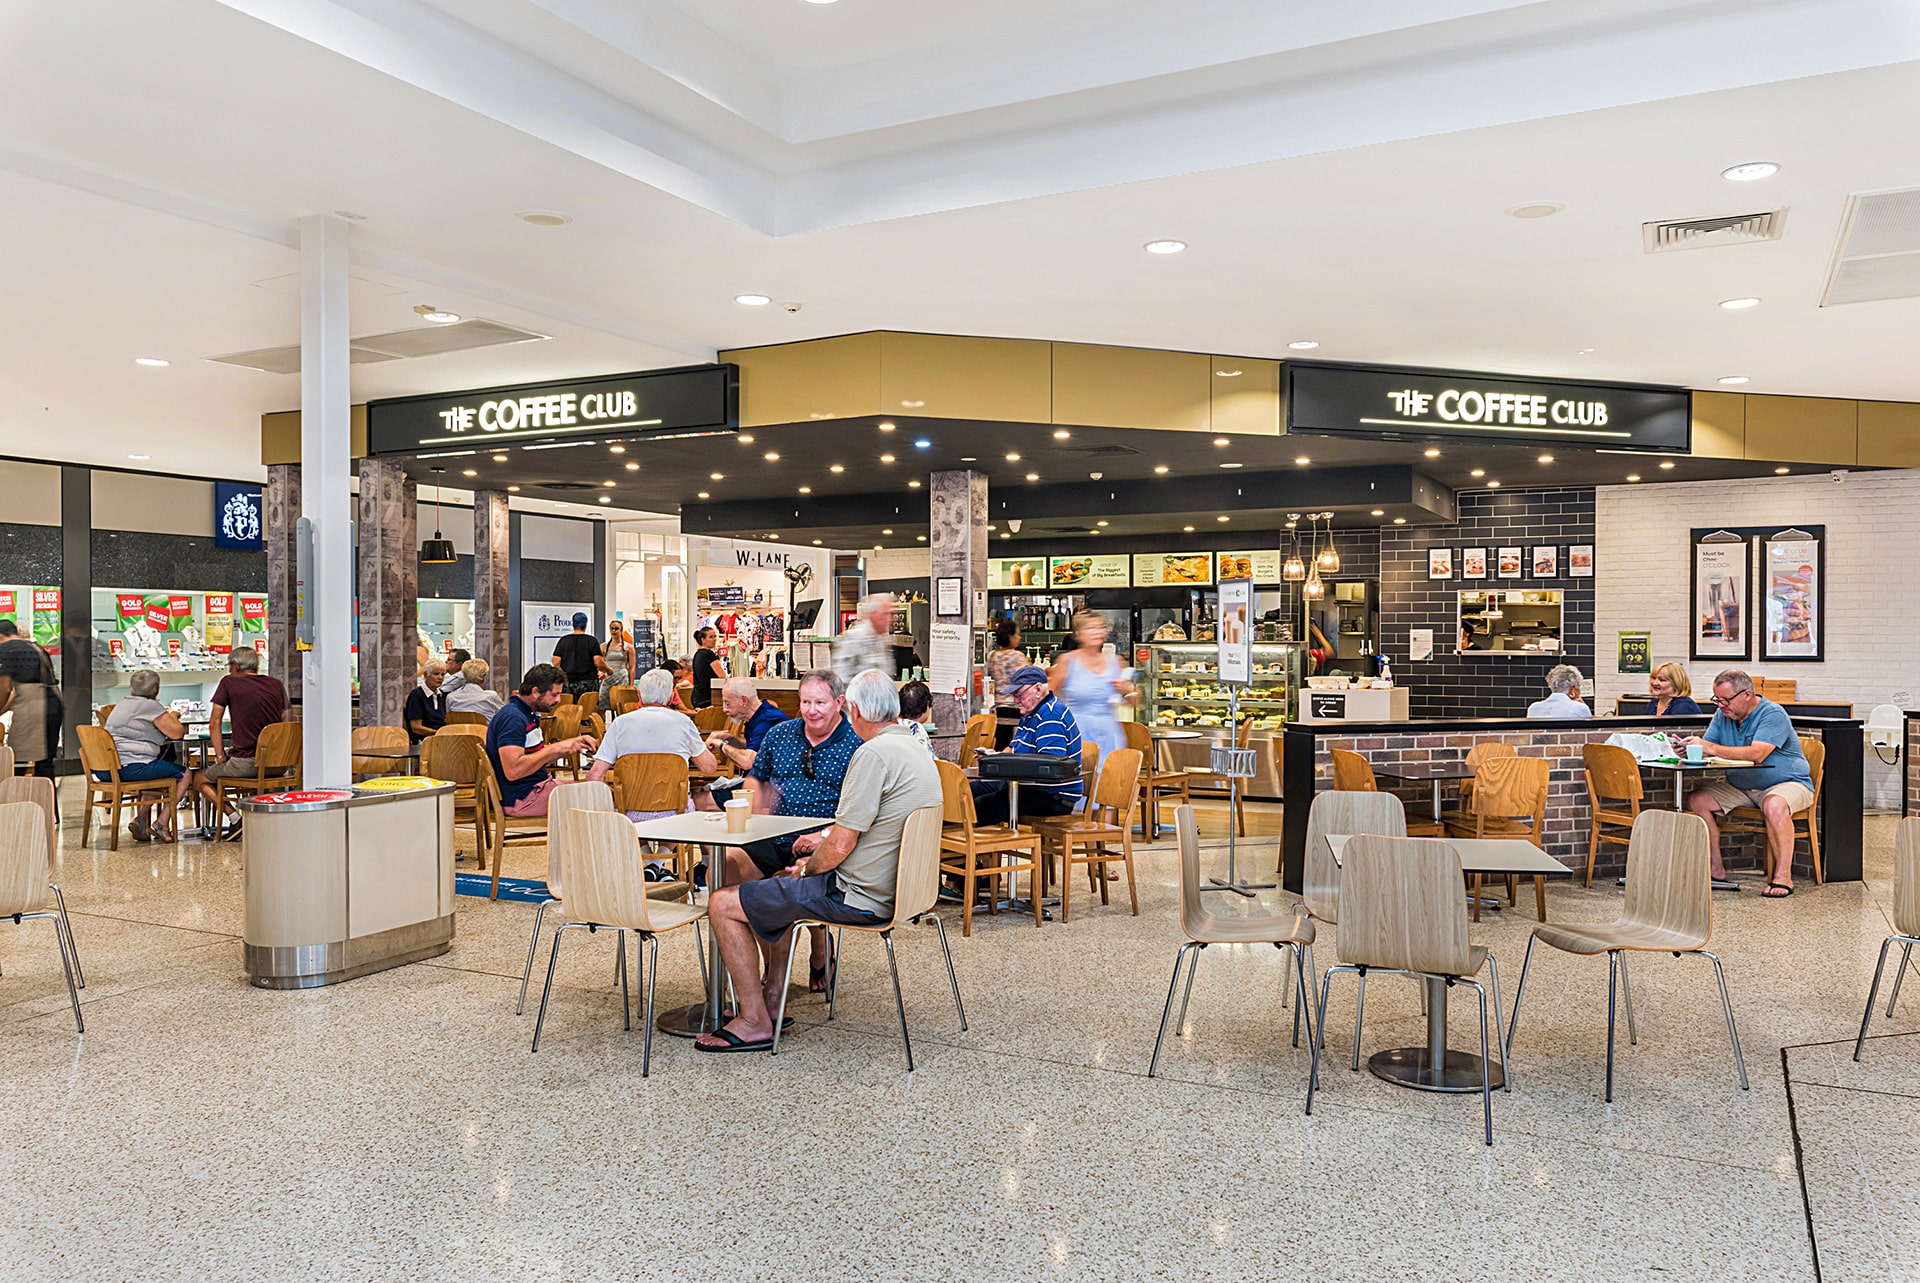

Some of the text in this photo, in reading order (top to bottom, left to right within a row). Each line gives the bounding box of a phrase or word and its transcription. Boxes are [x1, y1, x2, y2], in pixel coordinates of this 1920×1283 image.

[438, 391, 637, 432] THE COFFEE CLUB
[1387, 389, 1608, 426] THE COFFEE CLUB
[35, 592, 57, 602] SILVER
[210, 597, 227, 606] GOLD
[121, 599, 142, 607] GOLD
[245, 602, 262, 610] GOLD
[149, 610, 168, 621] SILVER
